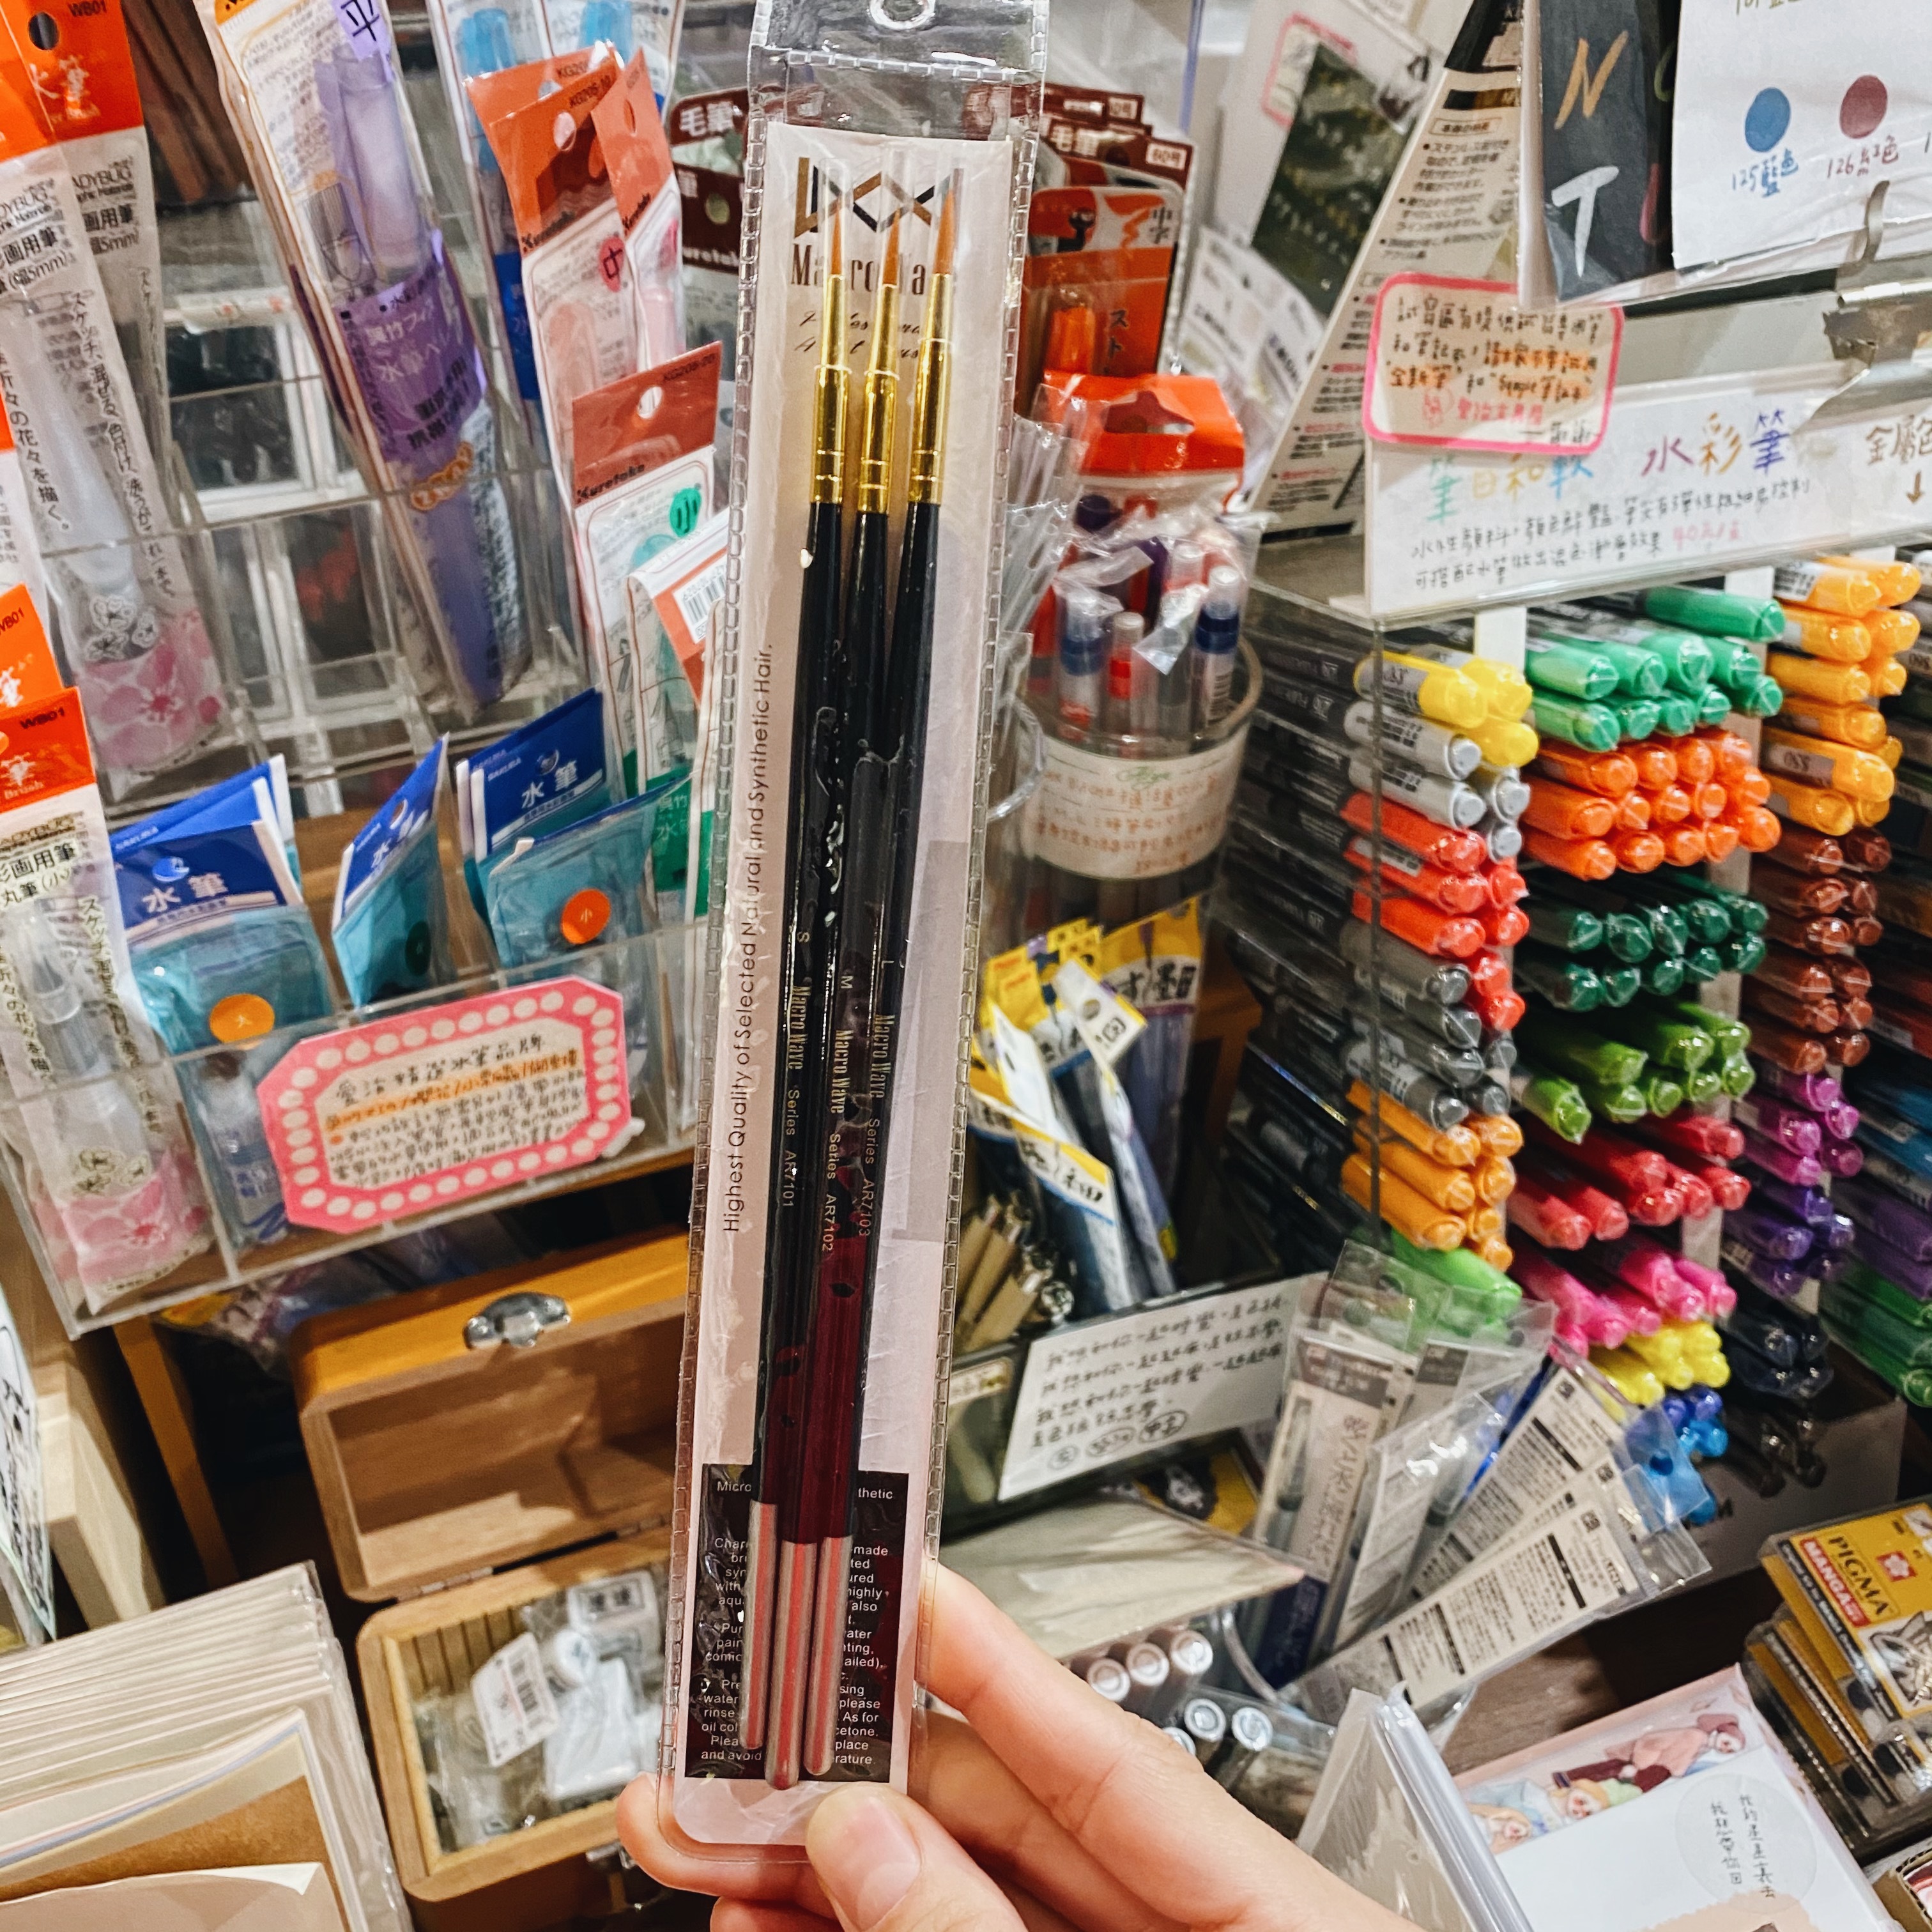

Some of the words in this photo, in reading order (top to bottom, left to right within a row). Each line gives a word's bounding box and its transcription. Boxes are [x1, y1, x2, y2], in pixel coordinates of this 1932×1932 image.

[748, 700, 770, 802] Synthetic
[748, 808, 766, 850] and
[741, 853, 762, 936] Natural
[734, 947, 756, 1038] Selected
[790, 985, 812, 1030] Macro
[733, 1039, 750, 1066] of
[788, 1034, 808, 1070] Wave
[832, 1029, 855, 1074] Macro
[872, 1014, 896, 1059] Macro
[831, 1077, 851, 1114] Wave
[870, 1062, 892, 1099] Wave
[728, 1073, 753, 1147] Quality
[786, 1089, 800, 1136] Series
[826, 1133, 841, 1180] Series
[865, 1118, 880, 1165] Series
[723, 1153, 745, 1233] Highest
[822, 1193, 838, 1252] AR7102
[714, 1537, 747, 1549] Char
[1828, 1535, 1889, 1616] PIGMA
[852, 1601, 878, 1612] also
[846, 1629, 872, 1639] ater
[839, 1699, 881, 1710] please
[862, 1712, 879, 1722] for
[701, 1750, 725, 1760] and
[834, 1740, 869, 1751] place
